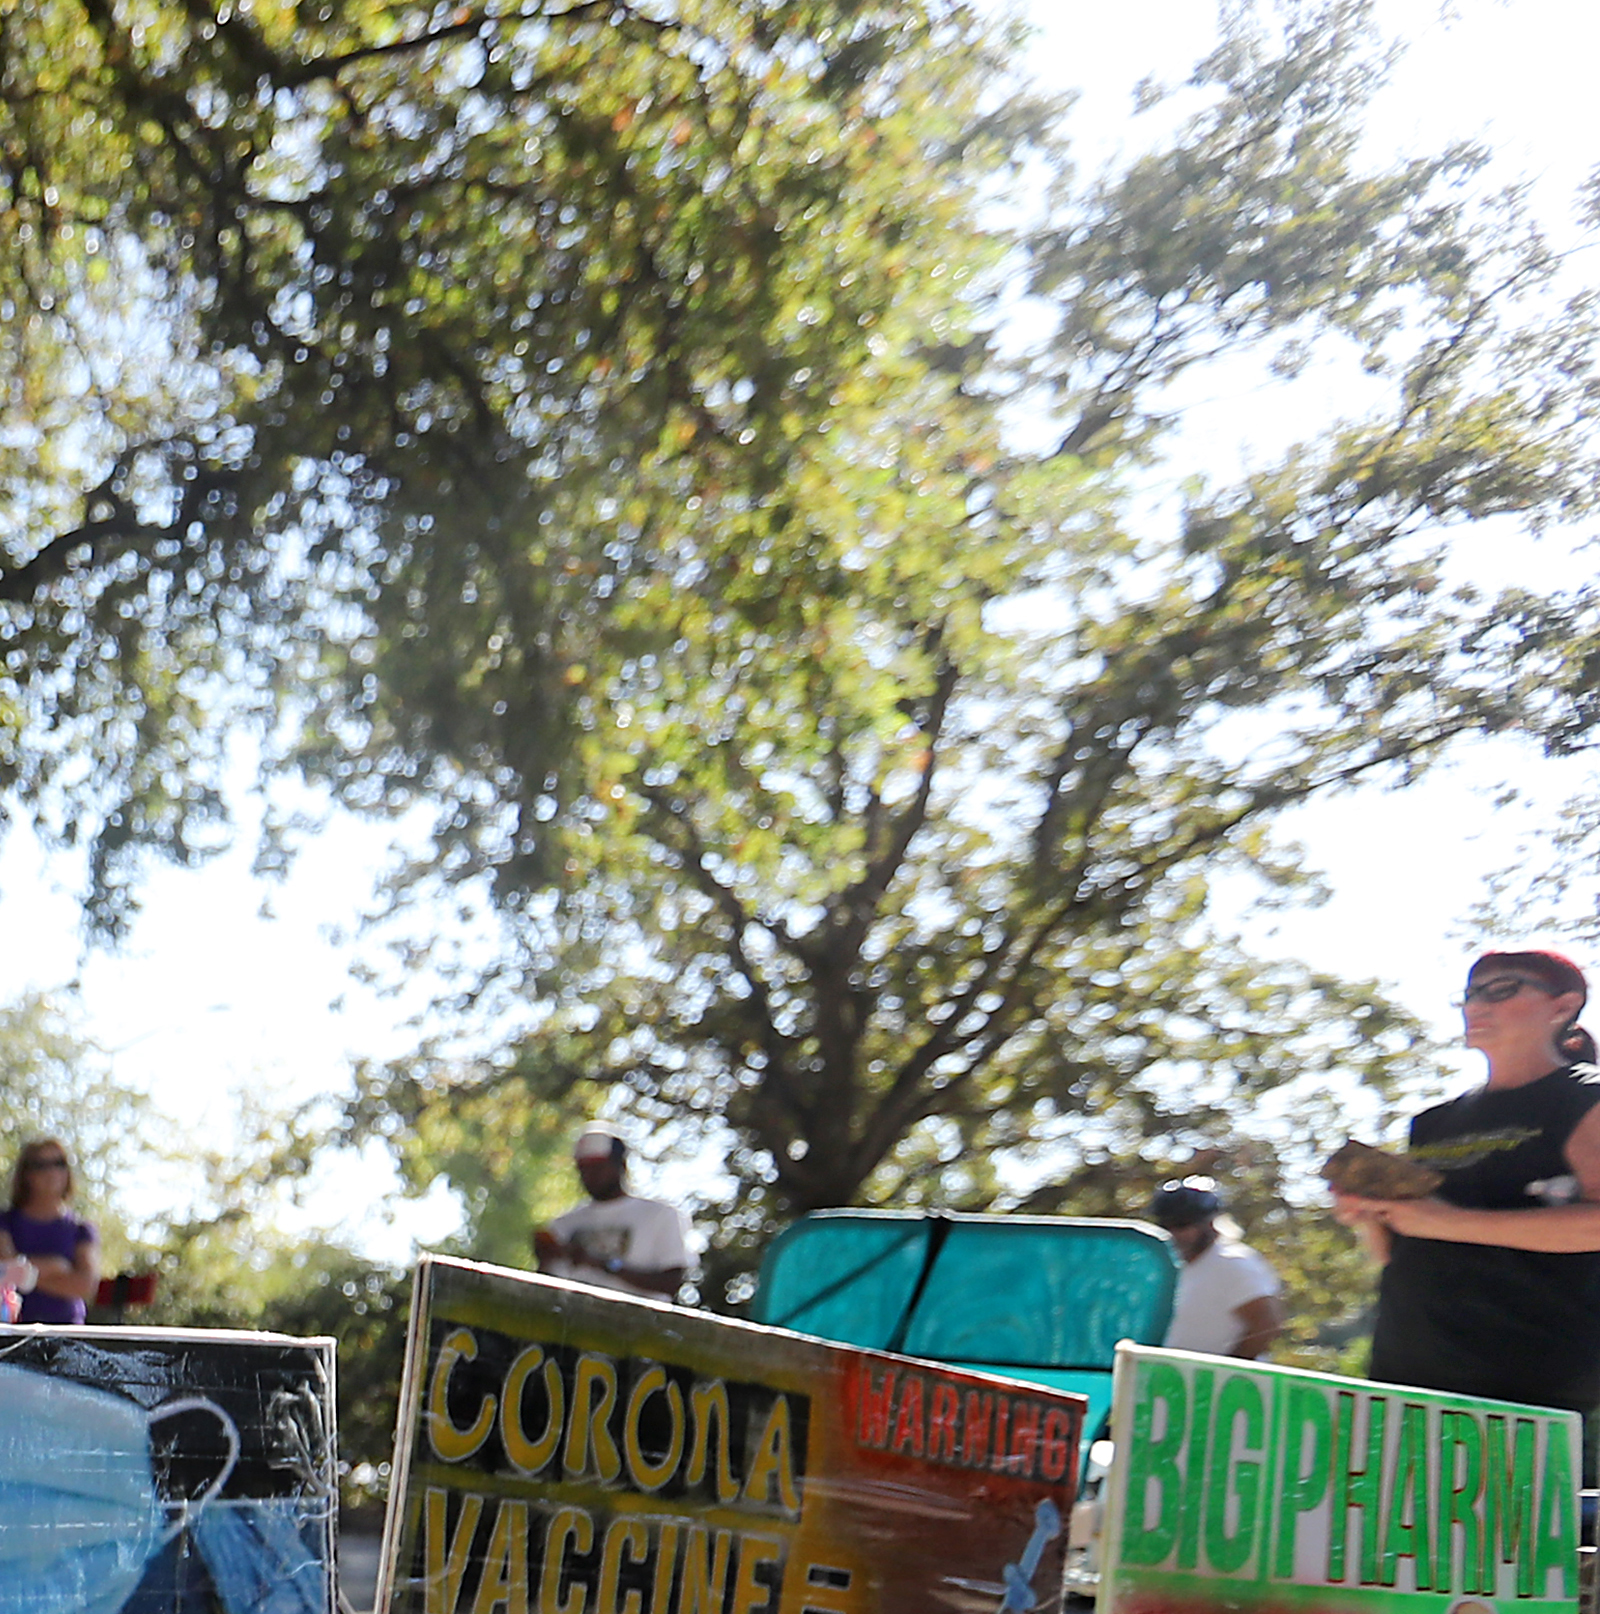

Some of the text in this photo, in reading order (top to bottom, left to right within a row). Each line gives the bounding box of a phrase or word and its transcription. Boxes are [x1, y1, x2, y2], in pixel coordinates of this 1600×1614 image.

[428, 1326, 798, 1516] CORONA
[858, 1366, 1072, 1484] WARNING
[1122, 1370, 1578, 1600] BIG PHARMA
